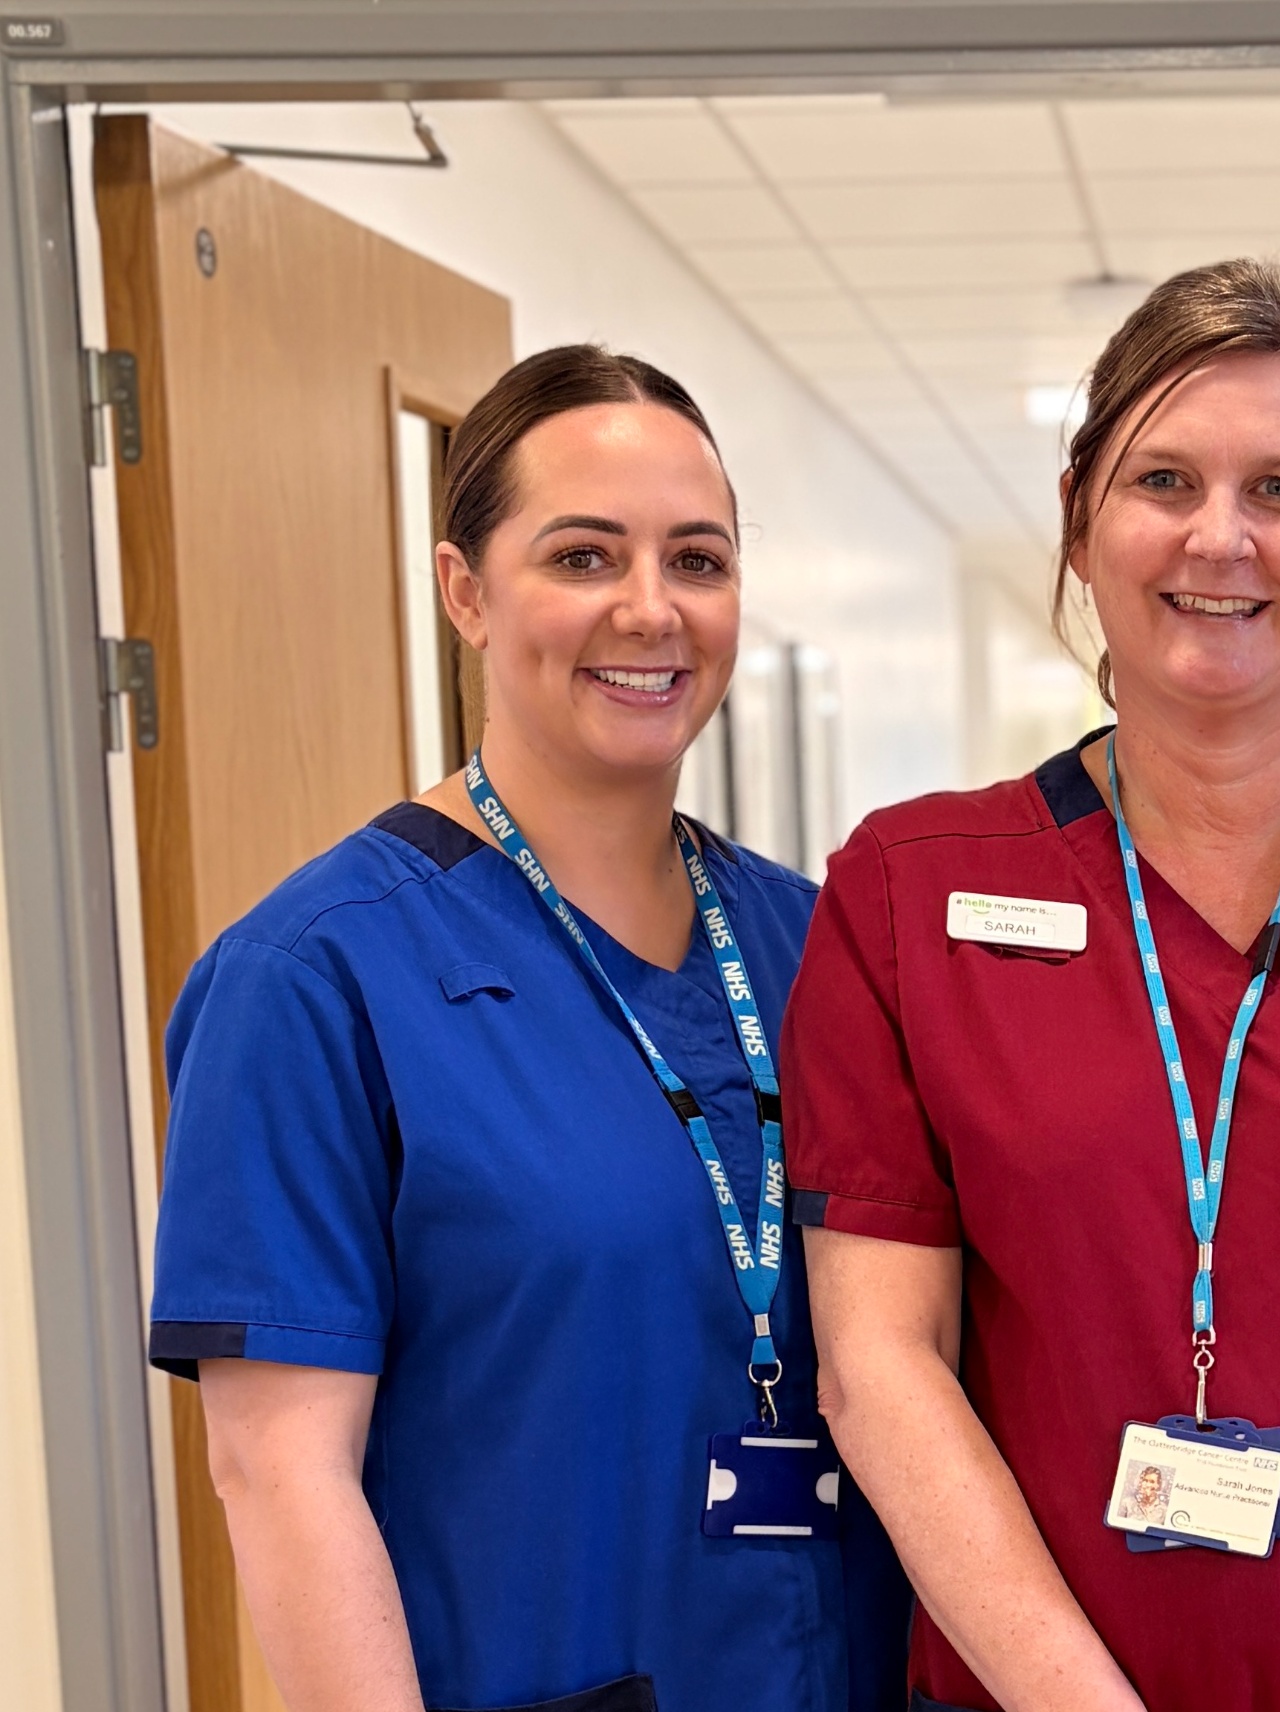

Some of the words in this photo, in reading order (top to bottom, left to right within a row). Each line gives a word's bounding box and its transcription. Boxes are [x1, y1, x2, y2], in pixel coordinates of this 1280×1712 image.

[8, 24, 51, 38] 00.567
[478, 797, 515, 840] NHS
[514, 848, 549, 893] NHS
[686, 854, 712, 896] NHS
[554, 903, 585, 945] NHS
[964, 898, 992, 908] hello
[995, 903, 1009, 911] my
[1011, 905, 1037, 914] name
[704, 906, 733, 949] NHS
[984, 921, 1036, 935] SARAH
[721, 961, 751, 1001] NHS
[738, 1014, 767, 1057] NHS
[706, 1158, 734, 1207] NHS
[765, 1158, 785, 1208] NHS
[727, 1223, 755, 1271] NHS
[760, 1221, 781, 1269] NHS
[1134, 1436, 1147, 1445] The
[1254, 1457, 1278, 1471] NHS
[1245, 1483, 1274, 1495] Jones
